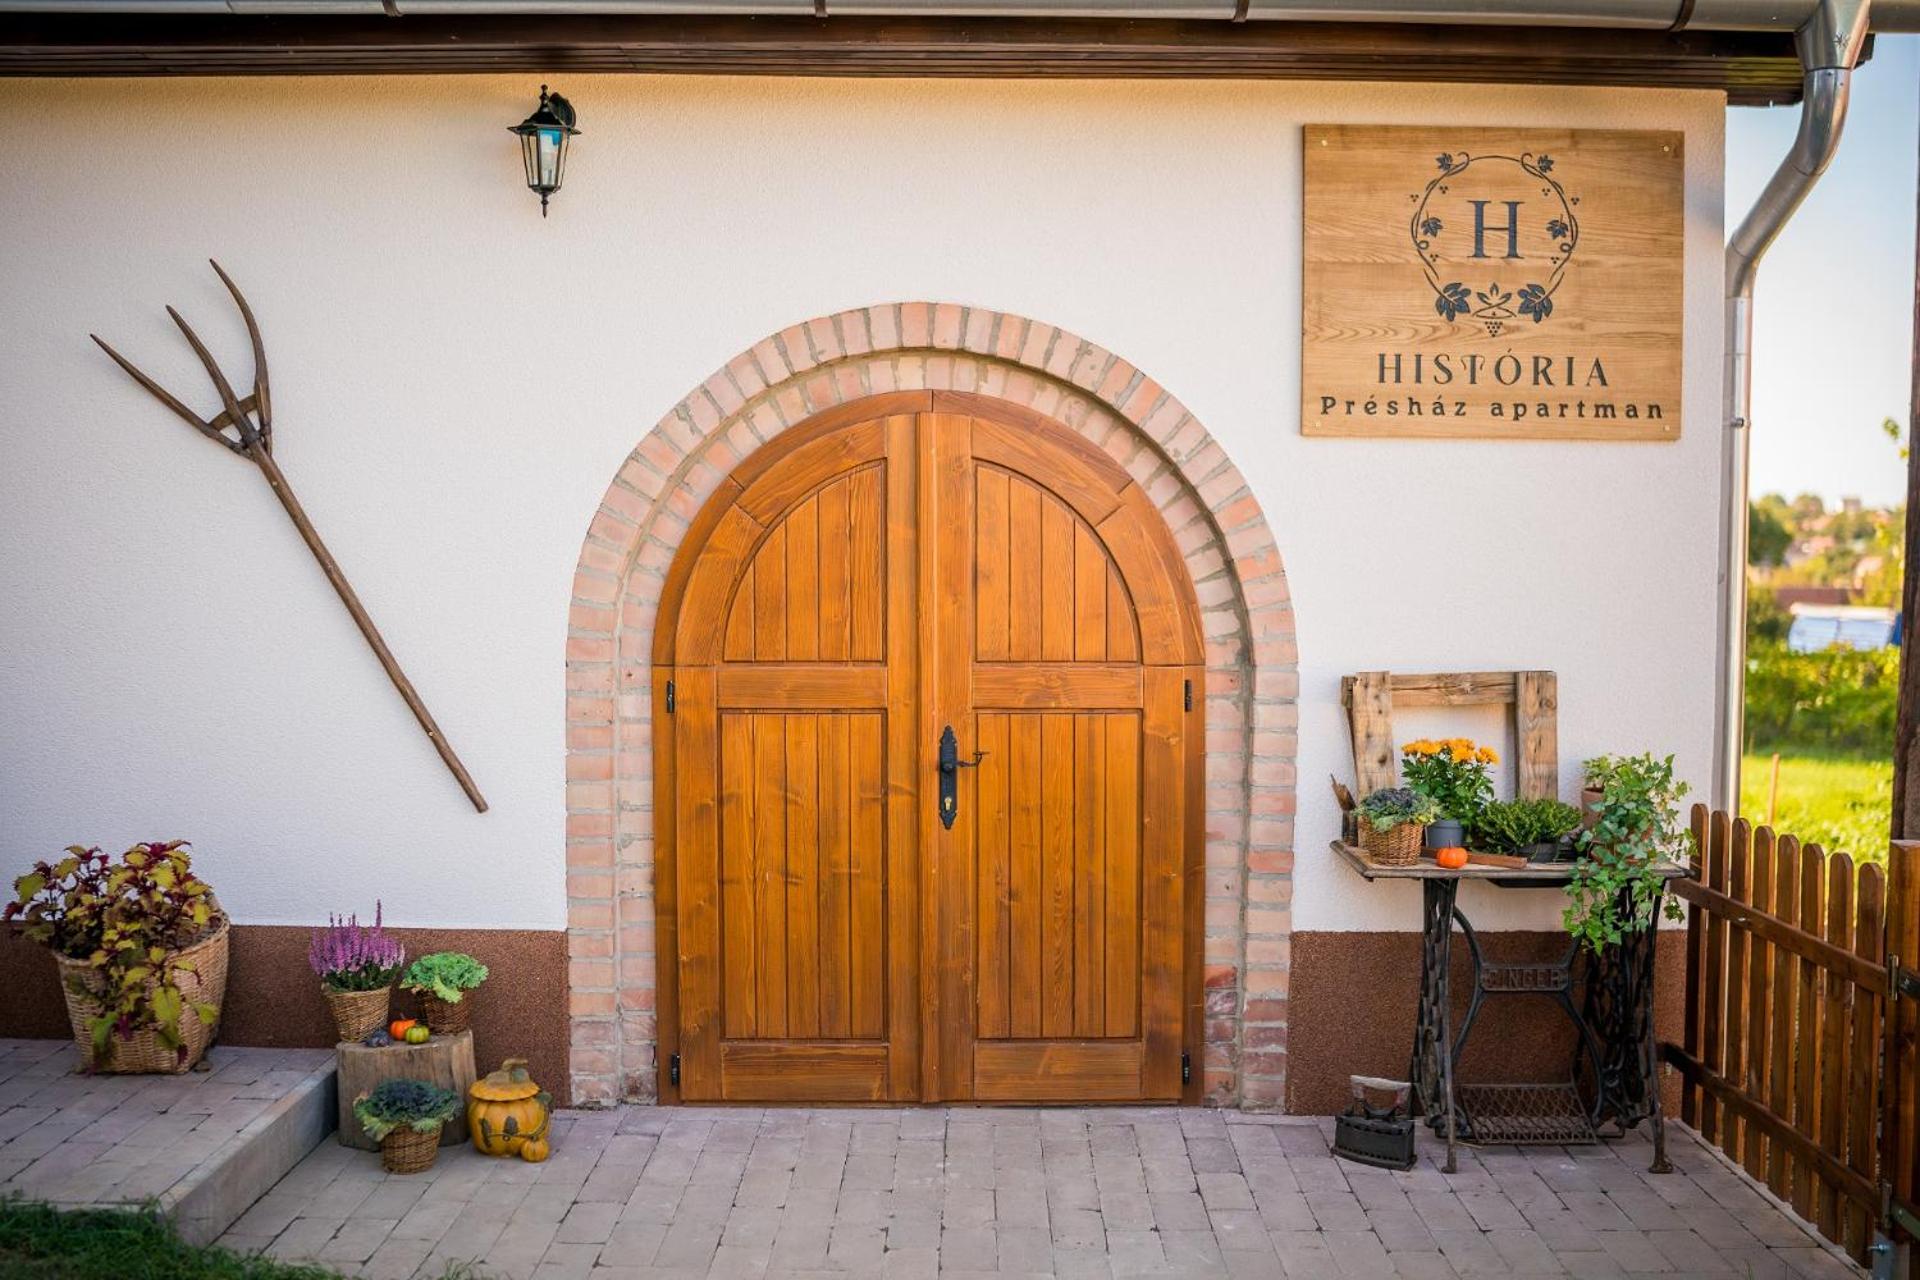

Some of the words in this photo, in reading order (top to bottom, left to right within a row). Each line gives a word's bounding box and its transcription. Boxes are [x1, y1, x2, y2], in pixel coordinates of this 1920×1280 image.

[1467, 200, 1525, 259] H
[1377, 348, 1609, 387] HISTÓRIA
[1320, 396, 1467, 416] Présház
[1490, 399, 1663, 421] apartman
